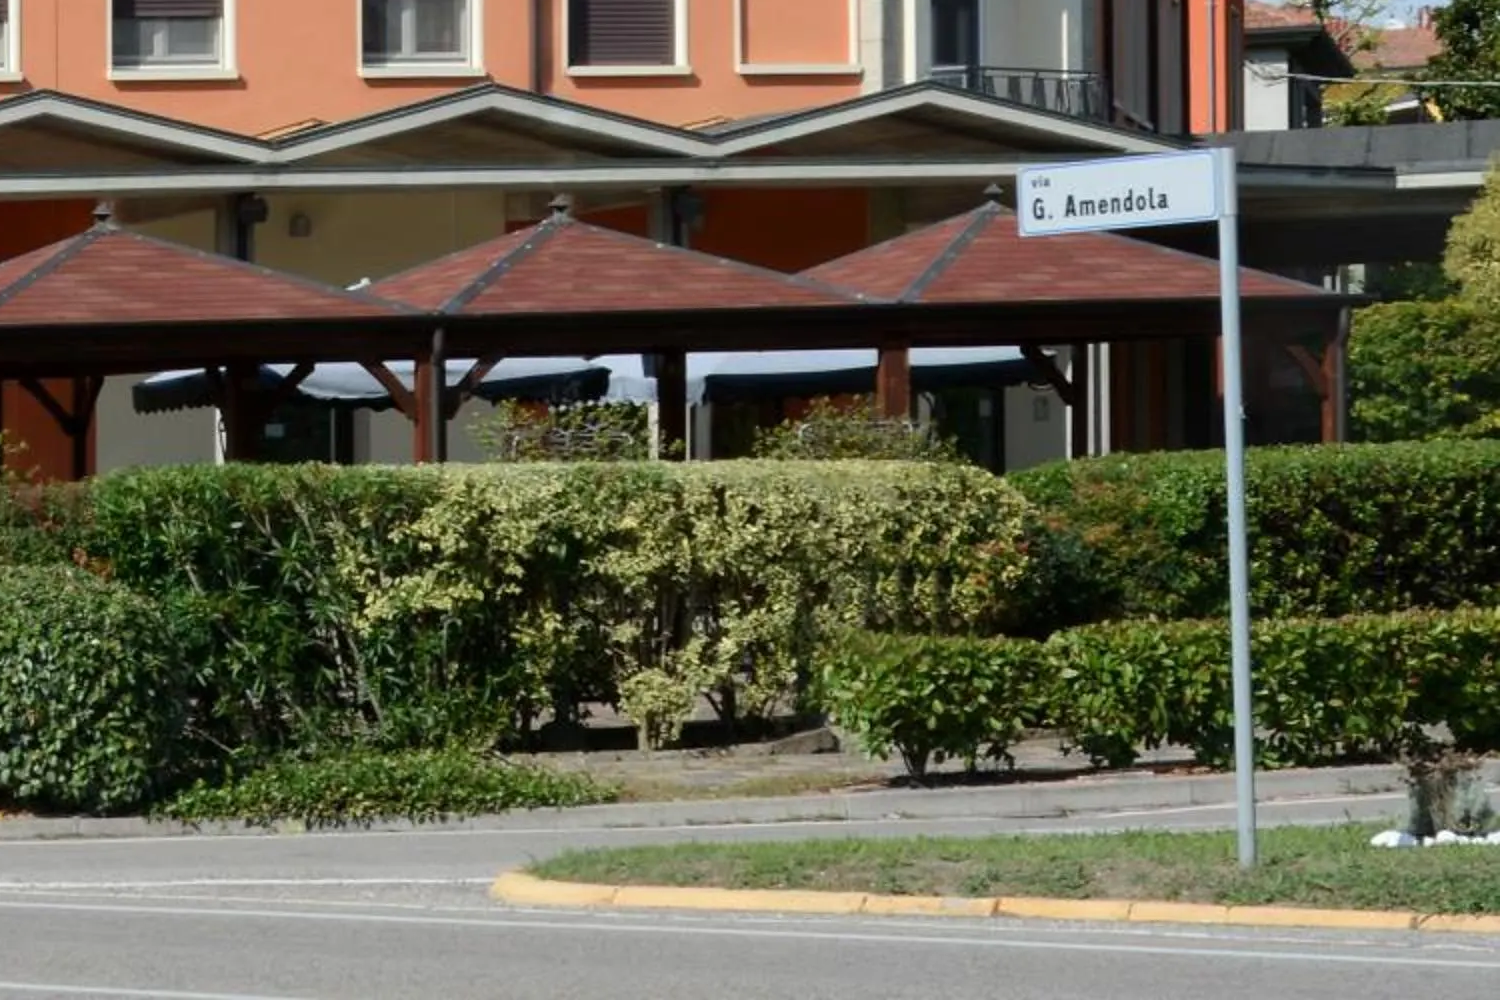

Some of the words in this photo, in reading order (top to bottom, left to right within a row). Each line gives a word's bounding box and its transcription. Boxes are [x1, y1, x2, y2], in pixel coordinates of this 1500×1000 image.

[1031, 176, 1050, 188] via
[1032, 198, 1054, 220] G.
[1064, 187, 1169, 217] Amendola
